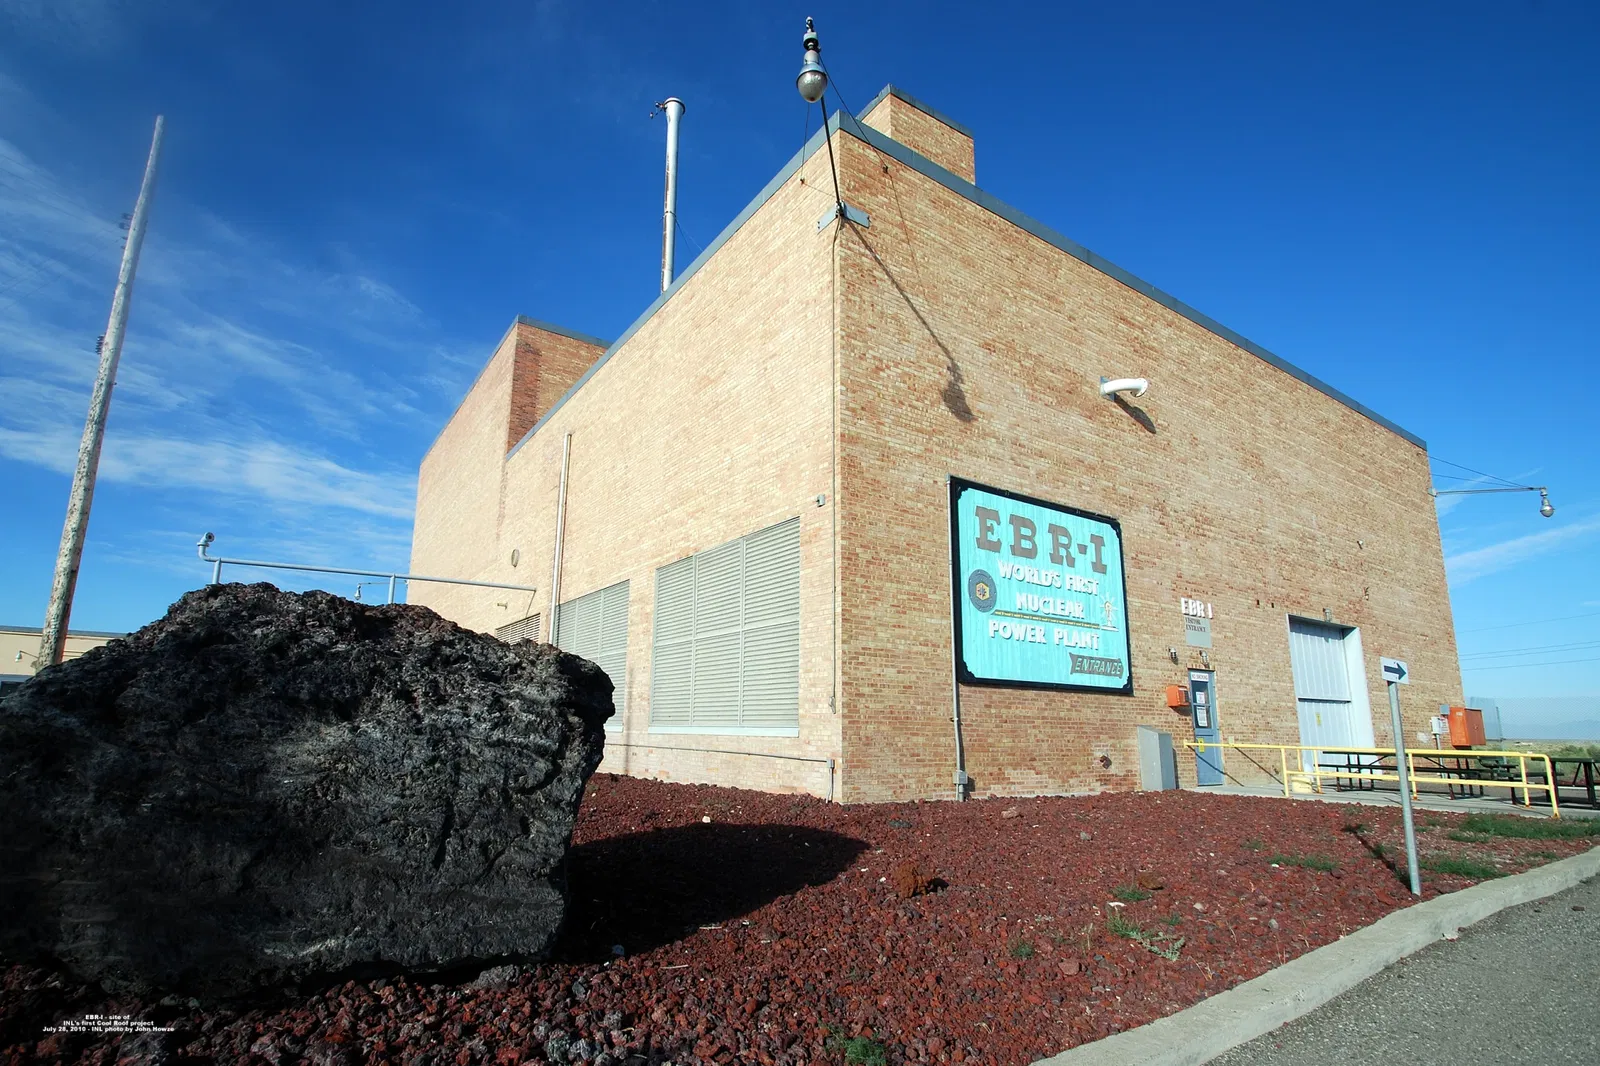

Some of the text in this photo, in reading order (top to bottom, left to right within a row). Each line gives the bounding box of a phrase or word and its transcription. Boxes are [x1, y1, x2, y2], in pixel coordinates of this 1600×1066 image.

[998, 560, 1100, 597] WORLD'S FIRST
[1016, 592, 1085, 619] NUCLEAR
[1181, 597, 1205, 618] EBR
[989, 620, 1100, 651] POWER PLANT
[1075, 657, 1122, 675] ENTRANCE
